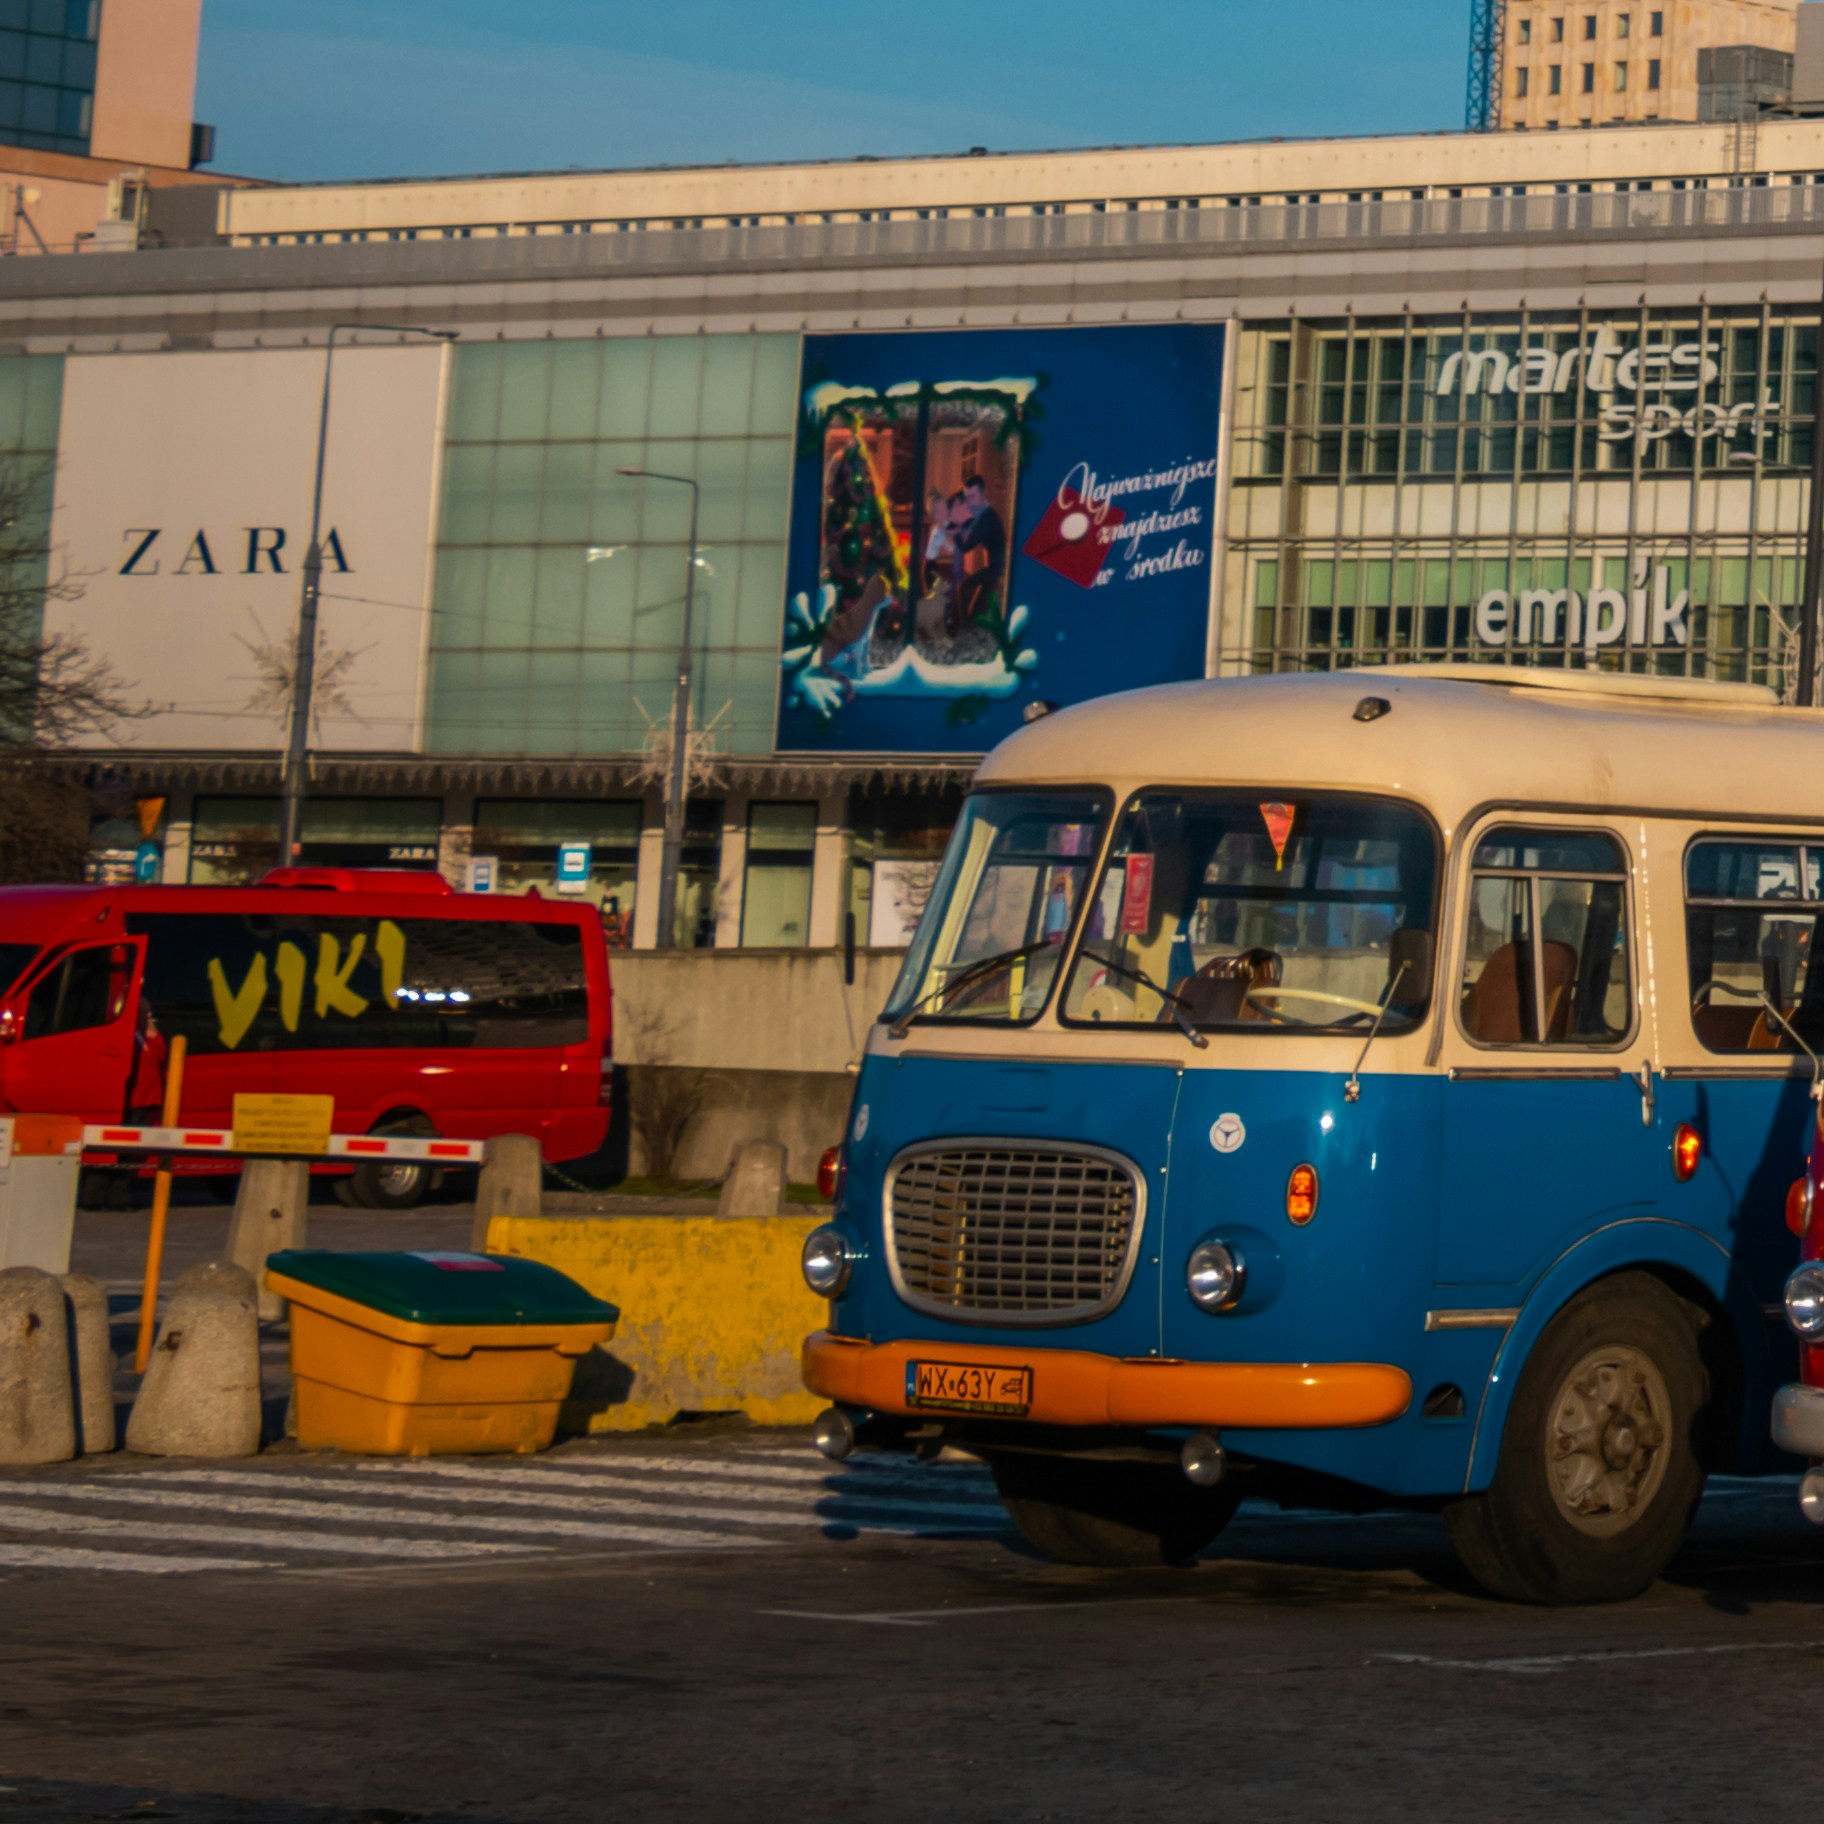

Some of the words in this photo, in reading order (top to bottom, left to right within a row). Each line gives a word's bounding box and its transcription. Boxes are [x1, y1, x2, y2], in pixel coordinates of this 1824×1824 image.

[1436, 325, 1721, 396] martes
[1599, 387, 1782, 456] sport
[1057, 455, 1217, 525] Najważniejsze
[118, 526, 356, 576] ZARA
[1092, 567, 1114, 588] w
[1125, 539, 1204, 581] środku
[1097, 506, 1202, 560] znajdziesz
[1476, 557, 1690, 650] empik
[389, 847, 436, 860] ZARA
[208, 920, 406, 1049] VIKI
[920, 1366, 948, 1397] WX
[957, 1369, 996, 1400] 63Y
